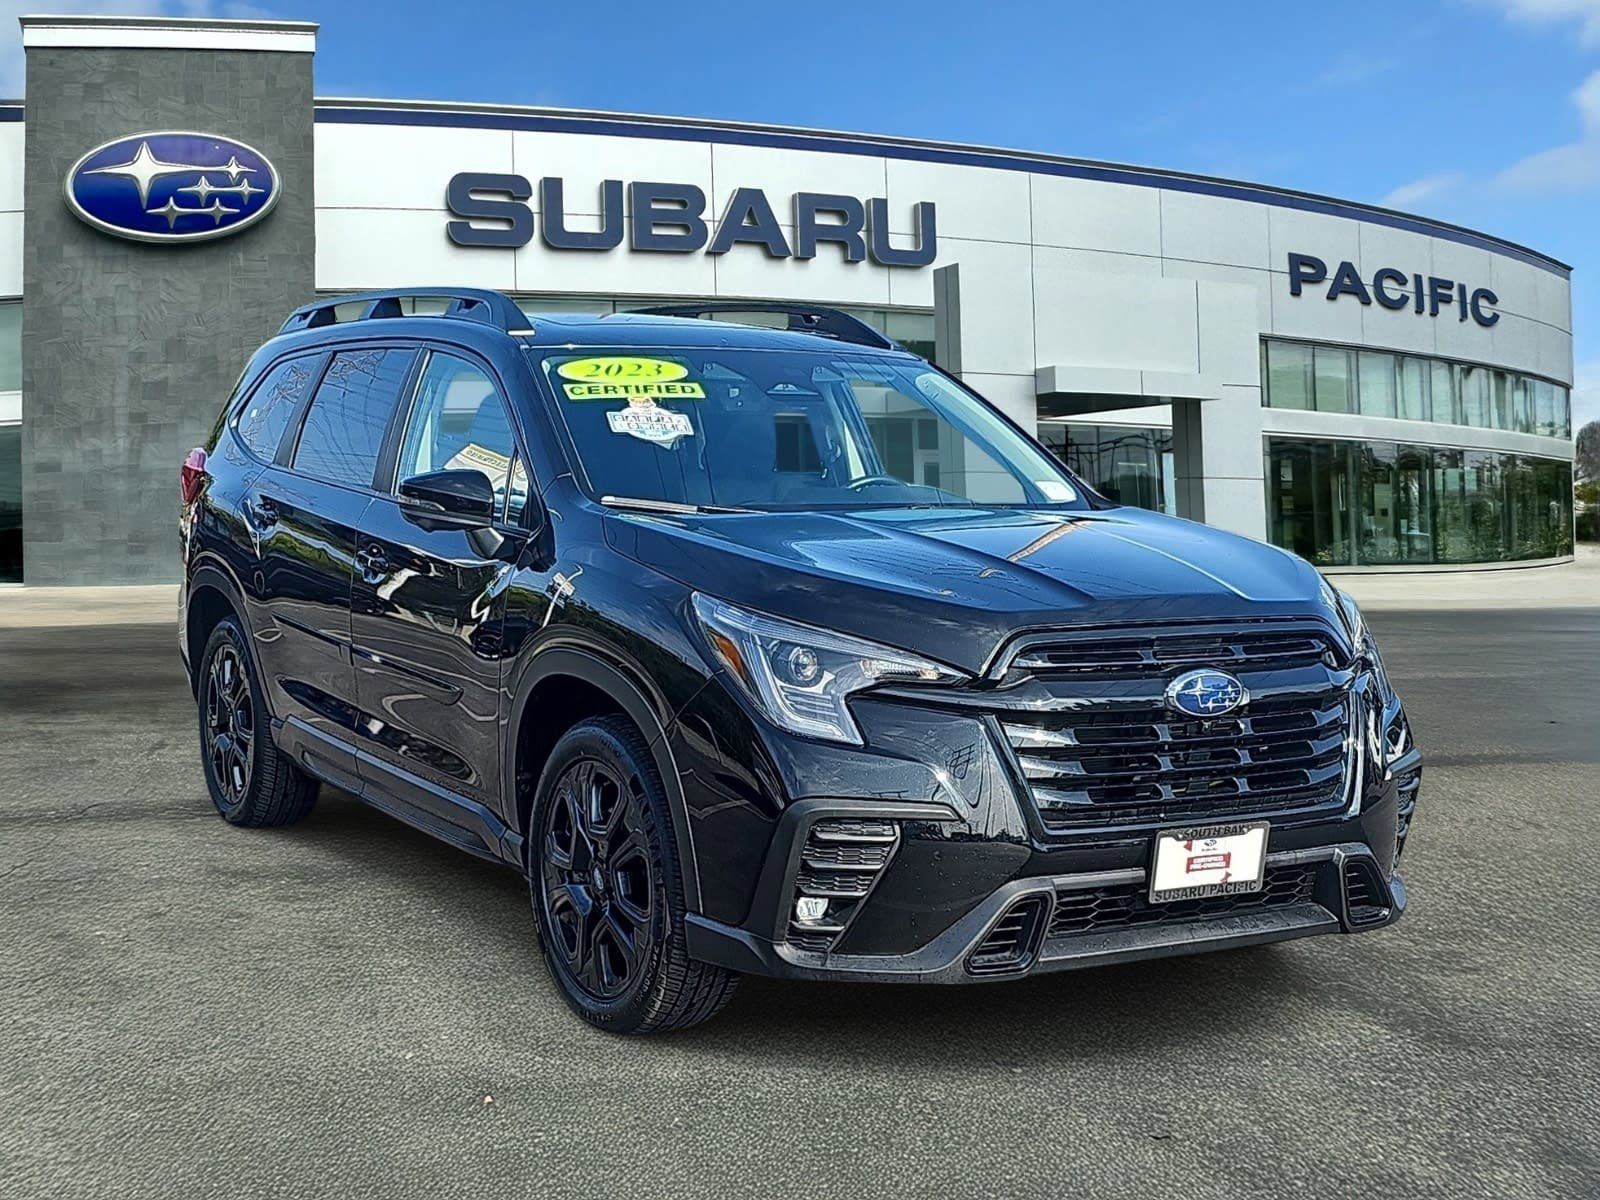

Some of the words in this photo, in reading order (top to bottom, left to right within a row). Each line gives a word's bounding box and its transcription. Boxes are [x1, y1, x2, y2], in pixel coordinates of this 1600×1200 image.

[446, 171, 937, 267] SUBARU
[1287, 251, 1500, 327] PACIFIC
[584, 364, 662, 377] 2023
[569, 384, 695, 395] CERTIFIED
[1183, 827, 1220, 838] SOUTH
[1223, 824, 1246, 836] BAY
[1155, 886, 1205, 901] SUBARU
[1210, 880, 1257, 894] PACIFIC
